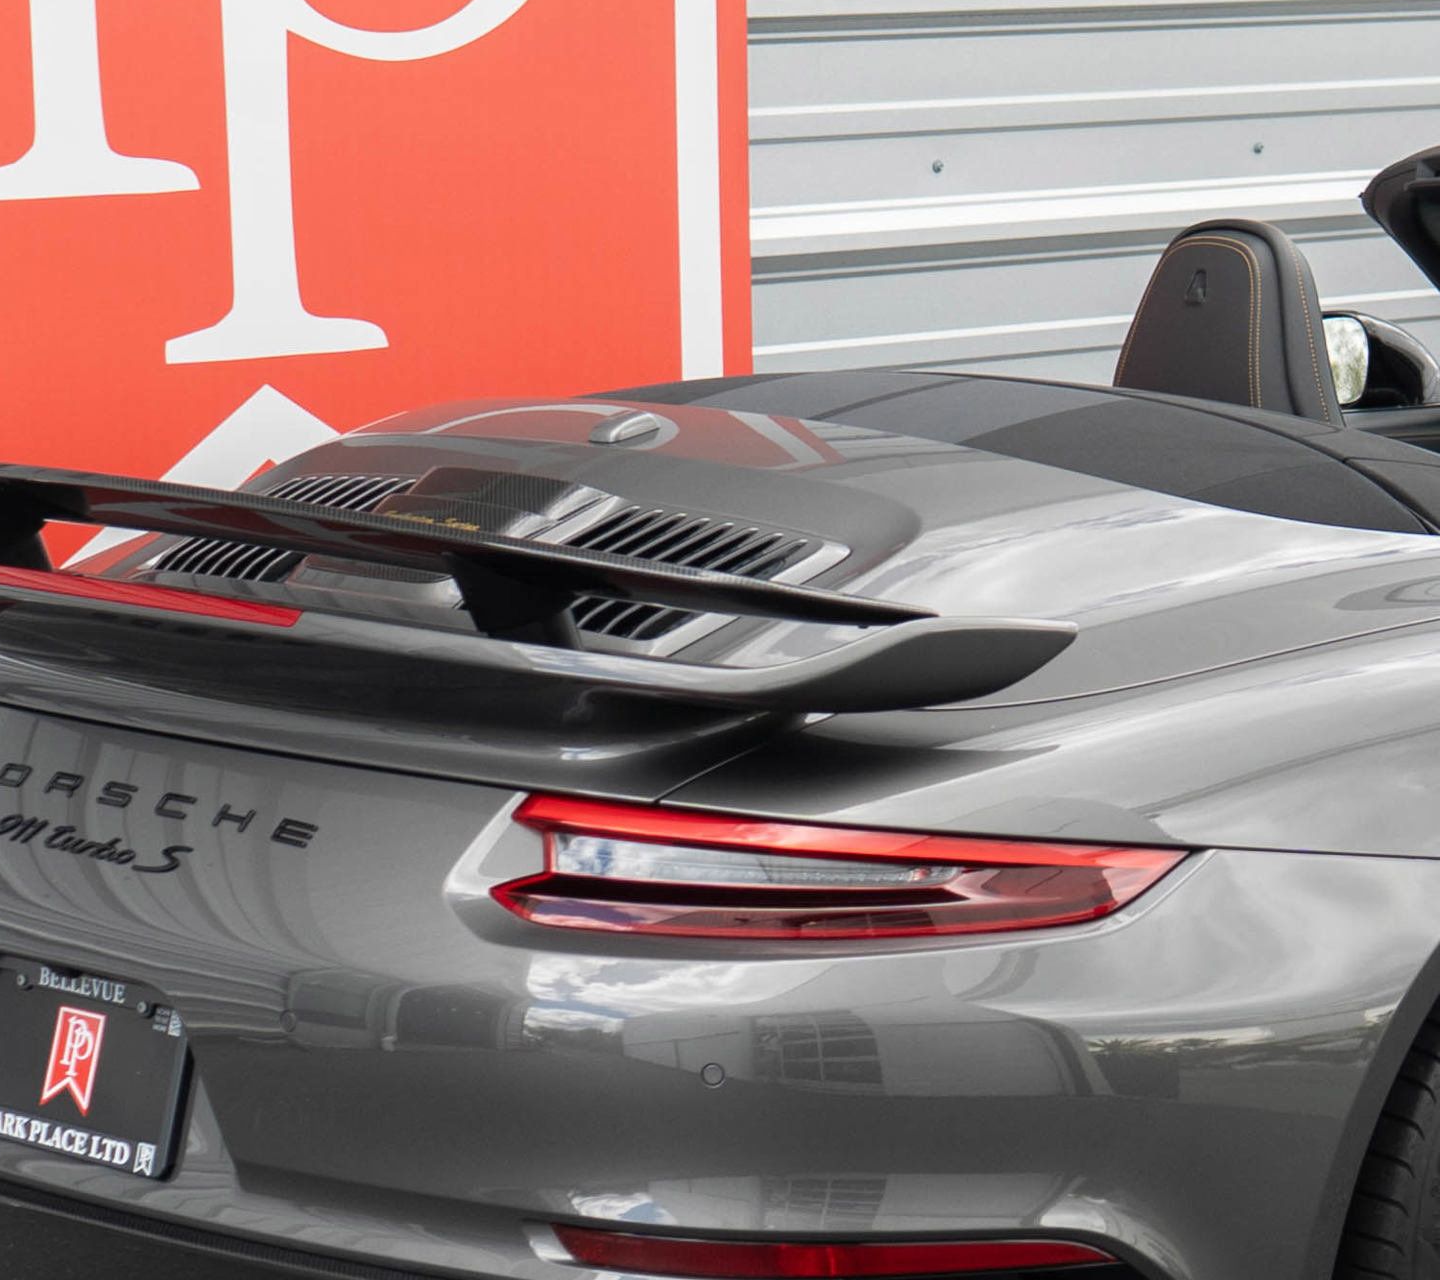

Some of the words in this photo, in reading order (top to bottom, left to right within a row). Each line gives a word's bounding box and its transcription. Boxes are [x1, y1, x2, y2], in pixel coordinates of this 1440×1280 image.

[44, 825, 137, 865] turbo
[131, 845, 194, 873] S
[38, 966, 126, 1004] BELLEVUE
[28, 1119, 89, 1155] PLACE
[88, 1135, 131, 1165] LTD
